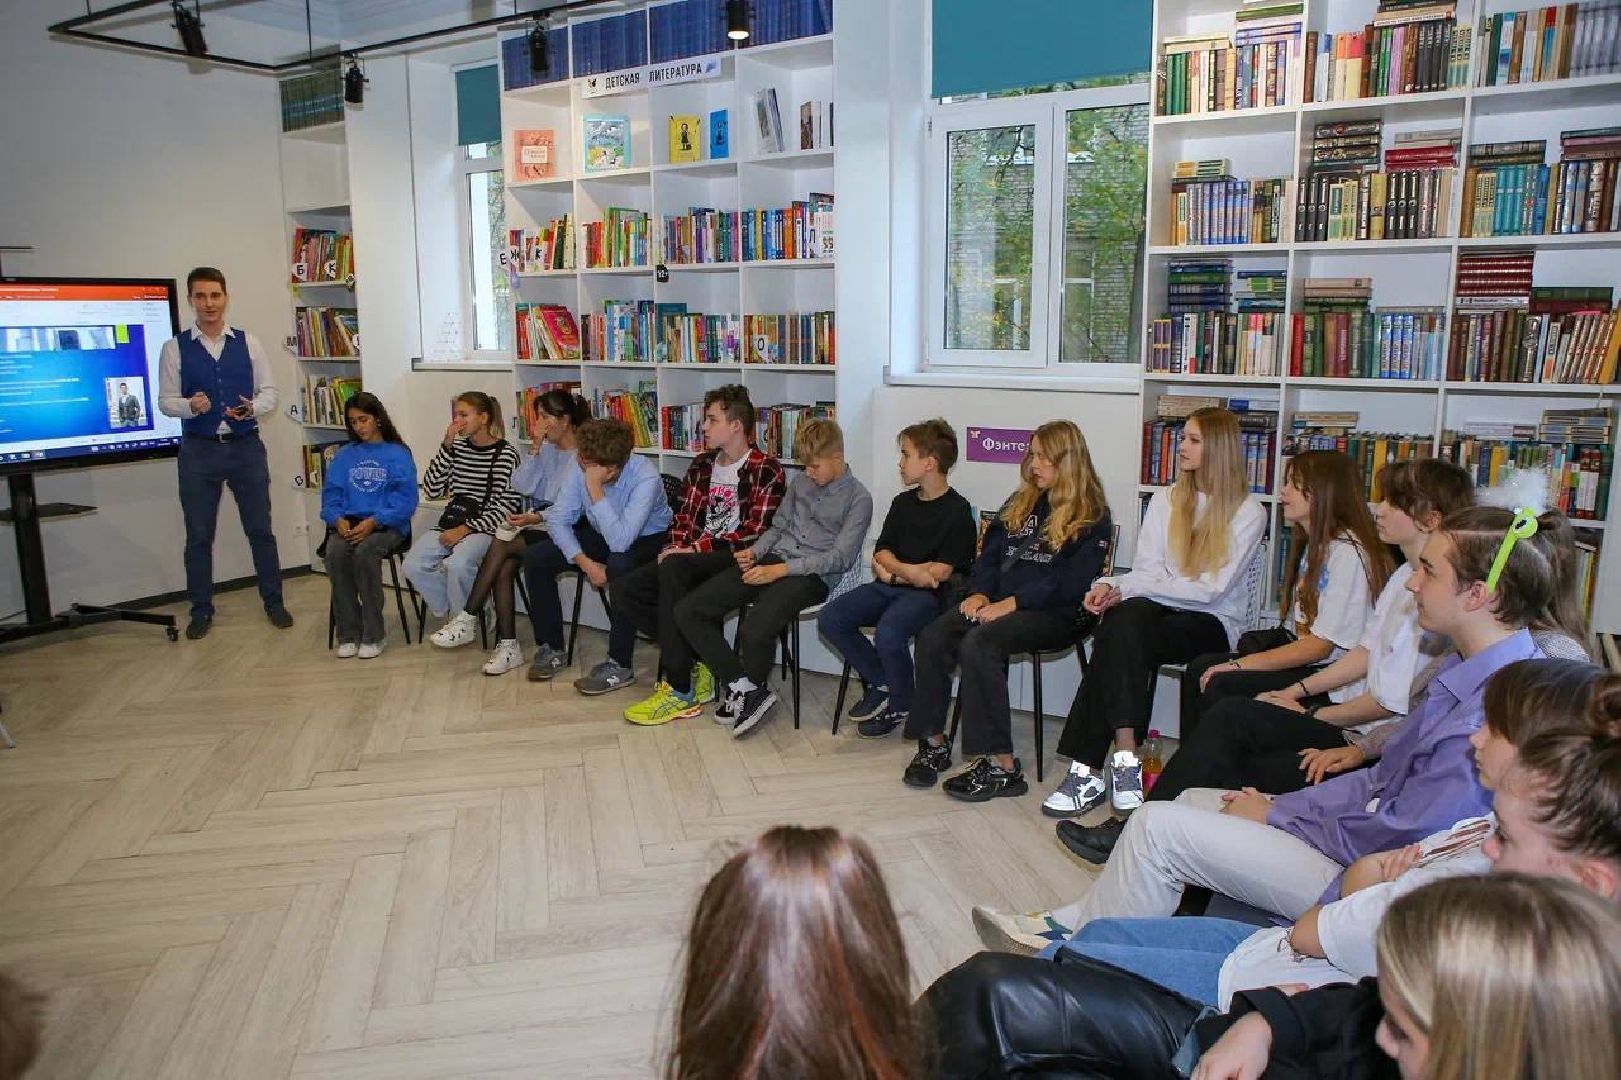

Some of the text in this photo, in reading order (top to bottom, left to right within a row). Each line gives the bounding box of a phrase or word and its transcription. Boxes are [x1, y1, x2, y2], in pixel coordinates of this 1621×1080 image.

[605, 63, 702, 89] ДЕТСКАЯ ЛИТЕРАТУРА
[296, 264, 305, 275] Б
[292, 404, 299, 415] А
